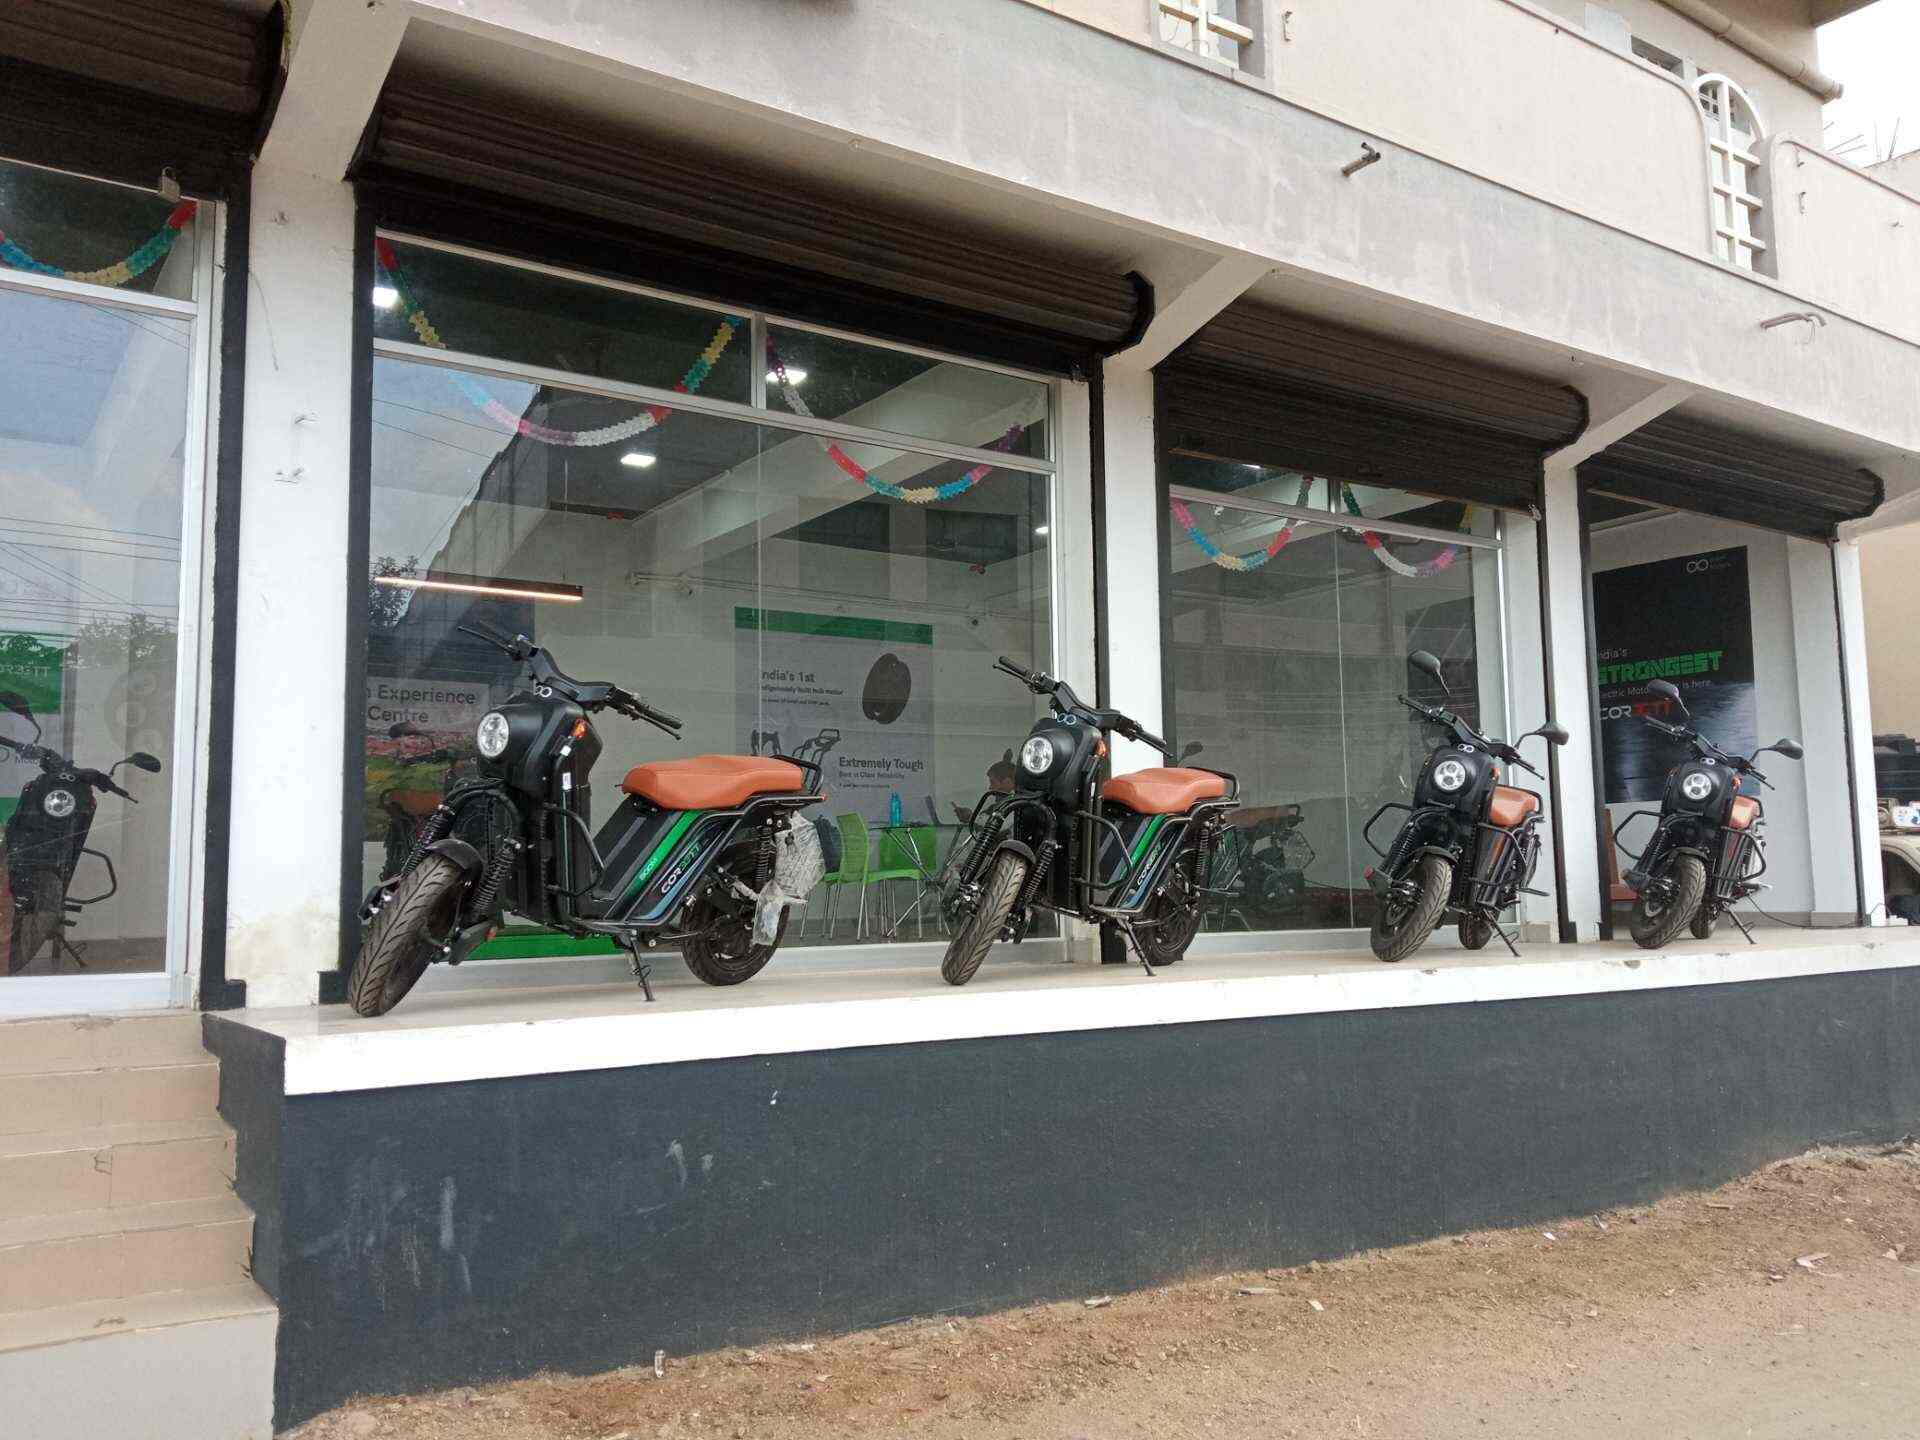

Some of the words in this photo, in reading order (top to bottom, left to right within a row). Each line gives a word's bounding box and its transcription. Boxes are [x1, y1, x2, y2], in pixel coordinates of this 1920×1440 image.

[760, 669, 796, 682] ndia's
[798, 671, 816, 683] 1st
[378, 684, 476, 705] Experience
[367, 705, 429, 723] Centre
[839, 756, 892, 771] Extremely
[893, 758, 924, 773] Tough
